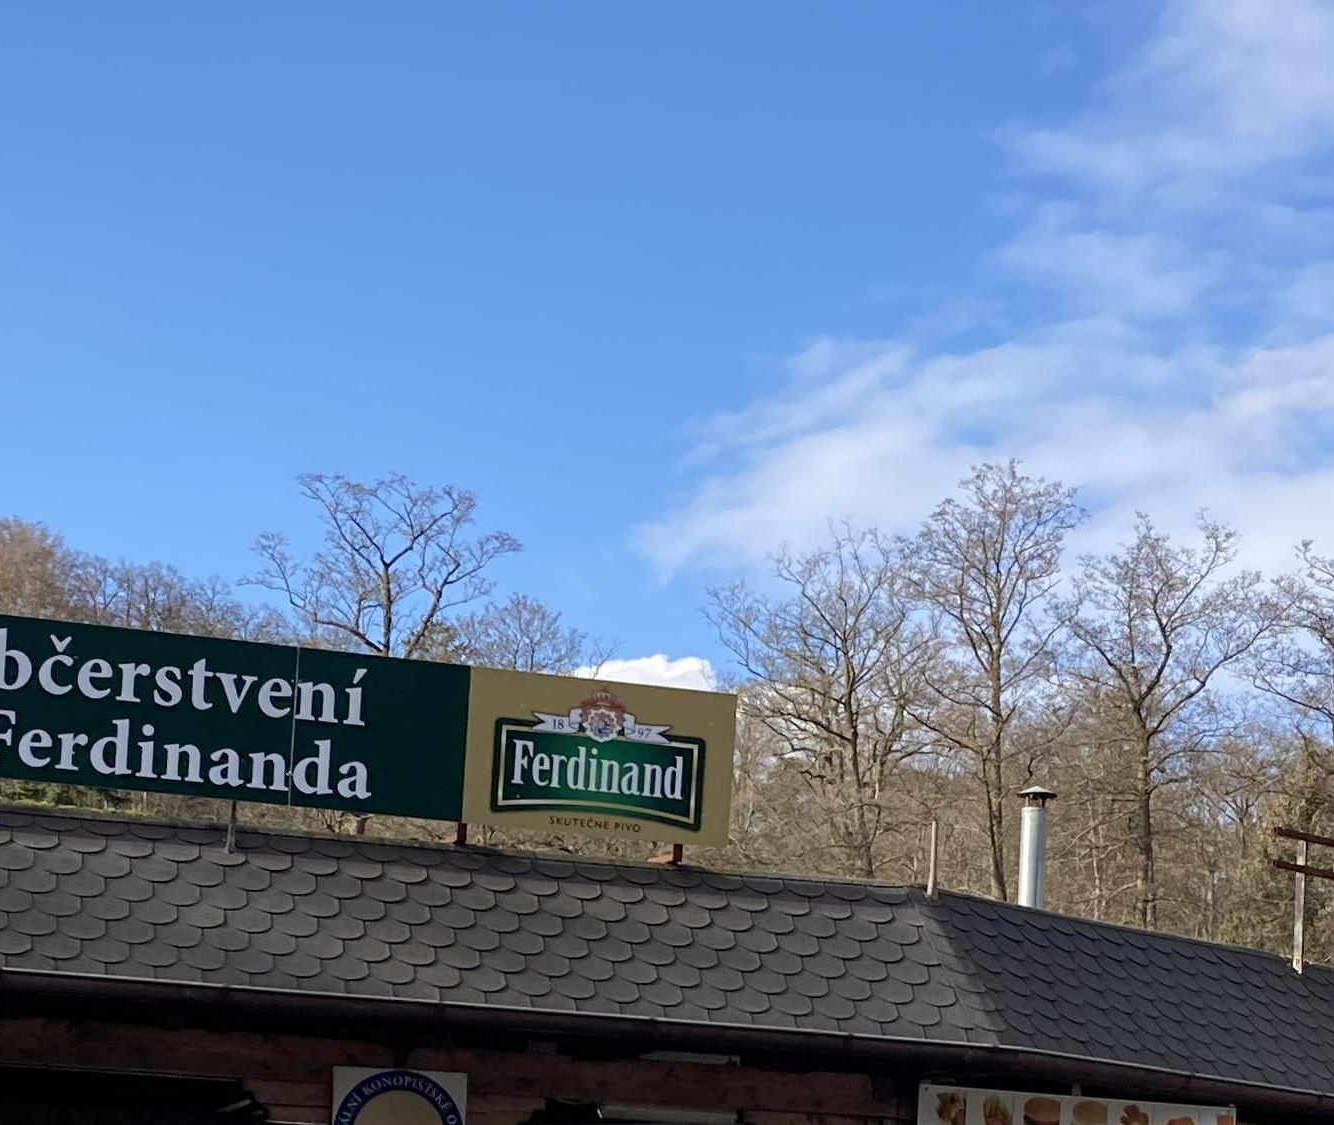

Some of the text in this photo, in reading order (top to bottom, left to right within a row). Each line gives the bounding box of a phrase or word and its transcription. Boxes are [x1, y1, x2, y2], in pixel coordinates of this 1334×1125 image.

[551, 718, 652, 737] 18 97
[510, 738, 684, 801] Ferdinand
[614, 821, 642, 833] PIVO
